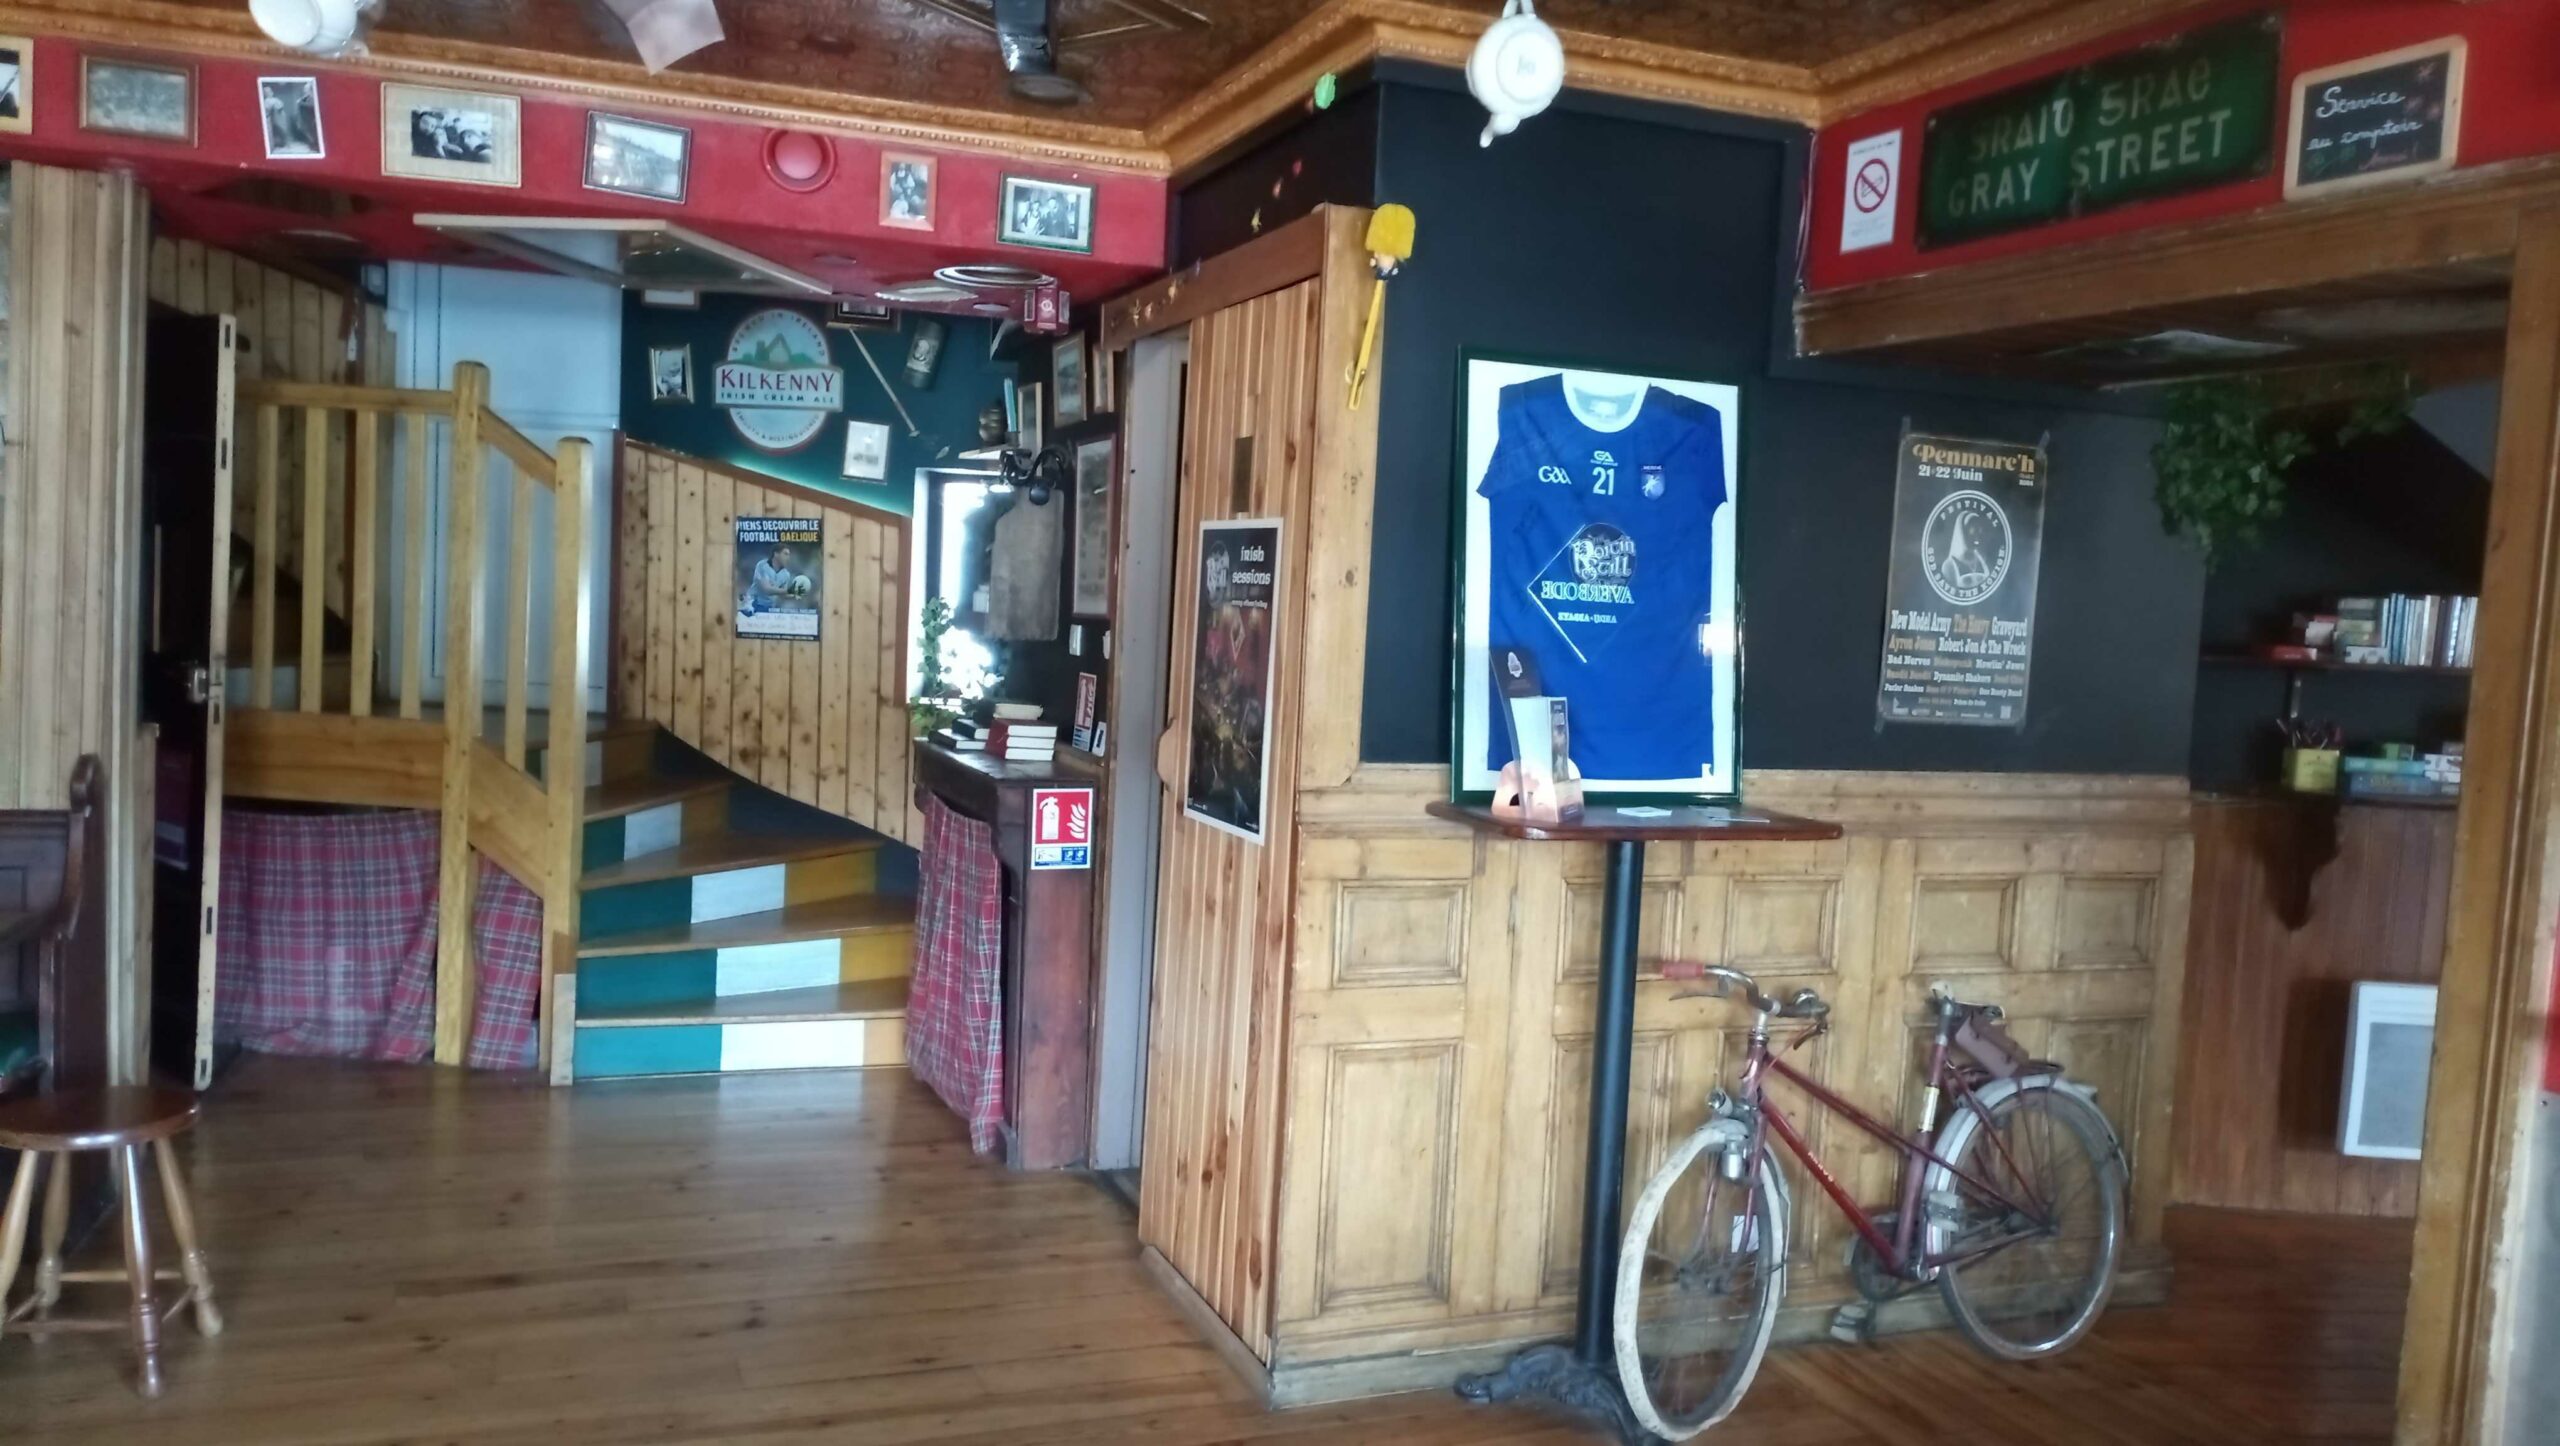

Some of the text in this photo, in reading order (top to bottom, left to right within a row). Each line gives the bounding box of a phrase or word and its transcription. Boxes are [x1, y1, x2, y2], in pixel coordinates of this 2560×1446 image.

[2315, 85, 2406, 118] Service
[2306, 119, 2424, 150] au comptoir
[1948, 108, 2232, 219] GRAY STREET
[721, 368, 835, 393] KILKENNY
[721, 392, 834, 404] IRISH CREAM ALE
[1912, 444, 2035, 473] Penmarc'h
[1592, 466, 1615, 496] 21
[1952, 468, 1983, 482] Juin
[1940, 500, 1999, 528] FESTIVAL
[762, 520, 809, 531] DECOUVRIR
[809, 520, 819, 531] LE
[740, 532, 818, 542] FOOTBALL GAELIQUE
[1240, 545, 1265, 562] irish
[1231, 568, 1271, 585] sessions
[1935, 572, 1957, 596] SAVE
[1958, 587, 1978, 598] THE
[1890, 610, 1908, 630] New
[1908, 611, 1931, 631] Model
[1931, 612, 1952, 637] Army
[1992, 616, 2028, 641] Graveyard
[1938, 637, 1964, 652] Robert
[1965, 638, 1979, 653] Jon
[1987, 640, 2002, 655] The
[2003, 641, 2027, 655] Wreck
[1887, 654, 1902, 664] Bad
[1904, 655, 1931, 666] Nerves
[1933, 671, 1964, 683] Dynamite
[1965, 672, 1991, 683] Shakers
